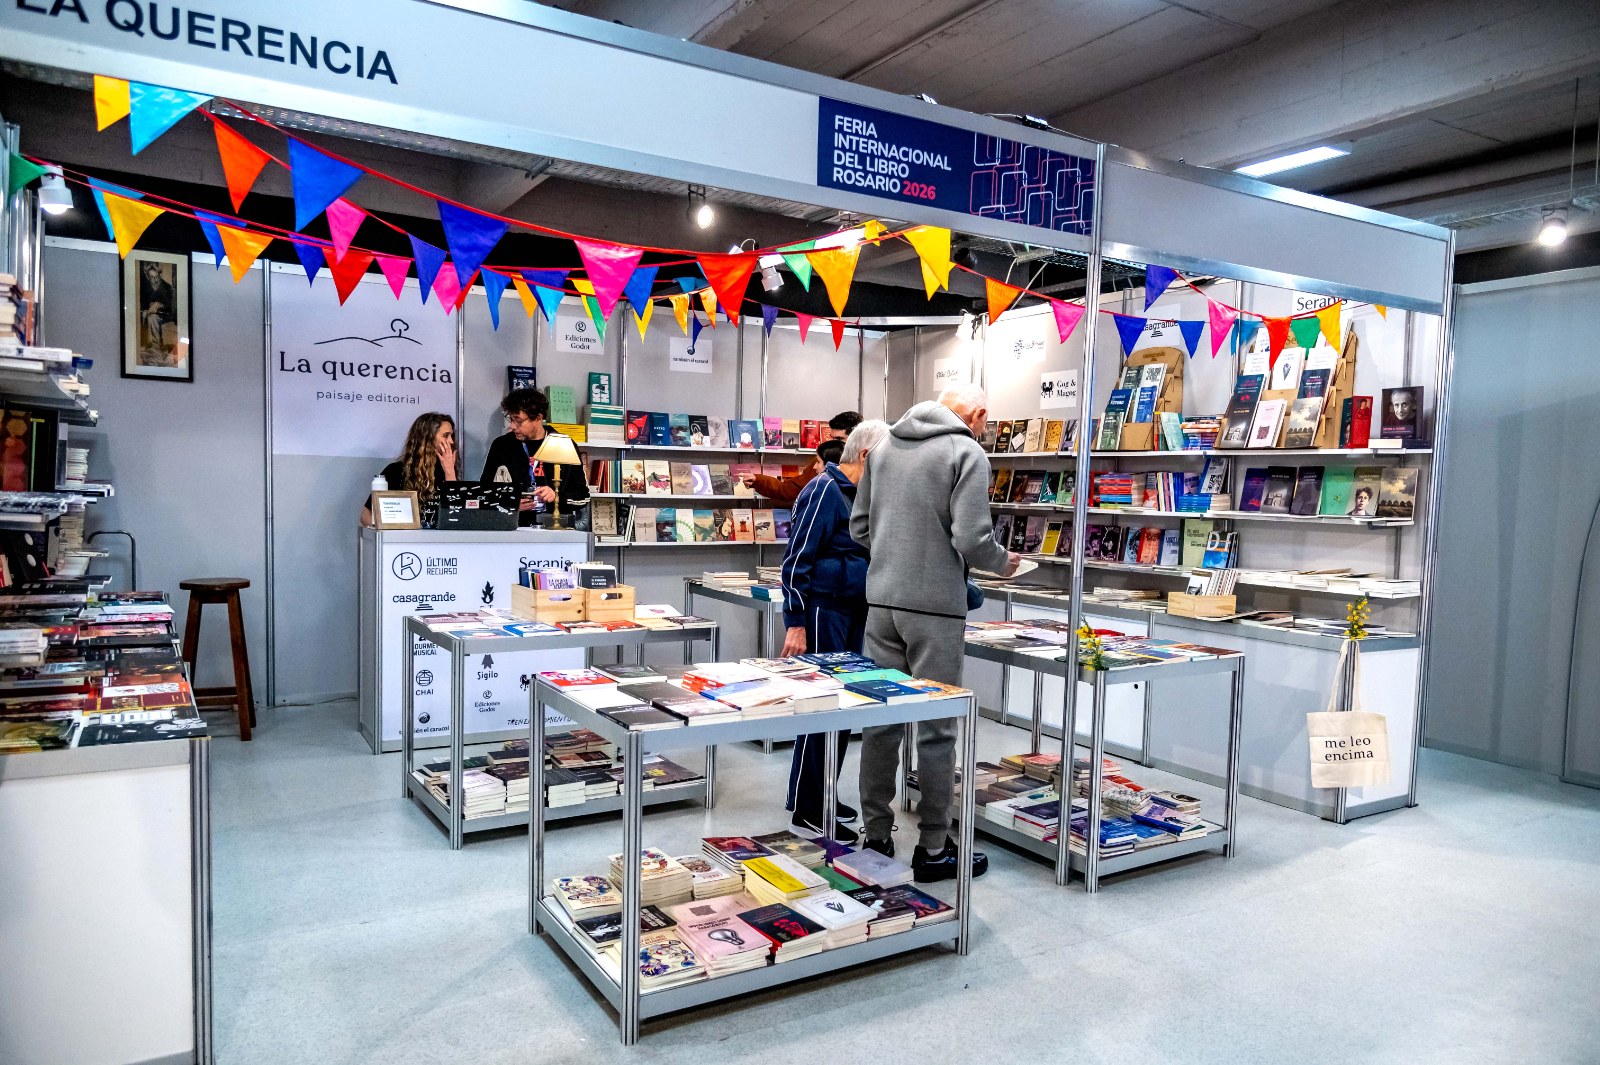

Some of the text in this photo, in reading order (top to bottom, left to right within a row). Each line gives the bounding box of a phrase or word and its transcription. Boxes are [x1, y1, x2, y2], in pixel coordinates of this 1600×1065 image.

[105, 0, 399, 85] QUERENCIA
[834, 115, 878, 138] FERIA
[834, 132, 952, 171] INTERNACIONAL
[833, 149, 910, 179] DEL LIBRO
[833, 167, 937, 201] ROSARIO 2026
[565, 334, 597, 343] Ediciones
[570, 342, 590, 350] Godot
[279, 351, 453, 384] La querencia
[1056, 380, 1069, 389] Gog
[316, 390, 421, 405] paisaje editorial
[1056, 389, 1077, 398] Magog
[426, 557, 458, 567] ÚLTIMO
[426, 567, 458, 576] RECURSO
[392, 592, 456, 603] casagrande
[477, 671, 499, 681] Sigilo
[1324, 736, 1371, 748] me leo
[1324, 749, 1374, 761] encima
